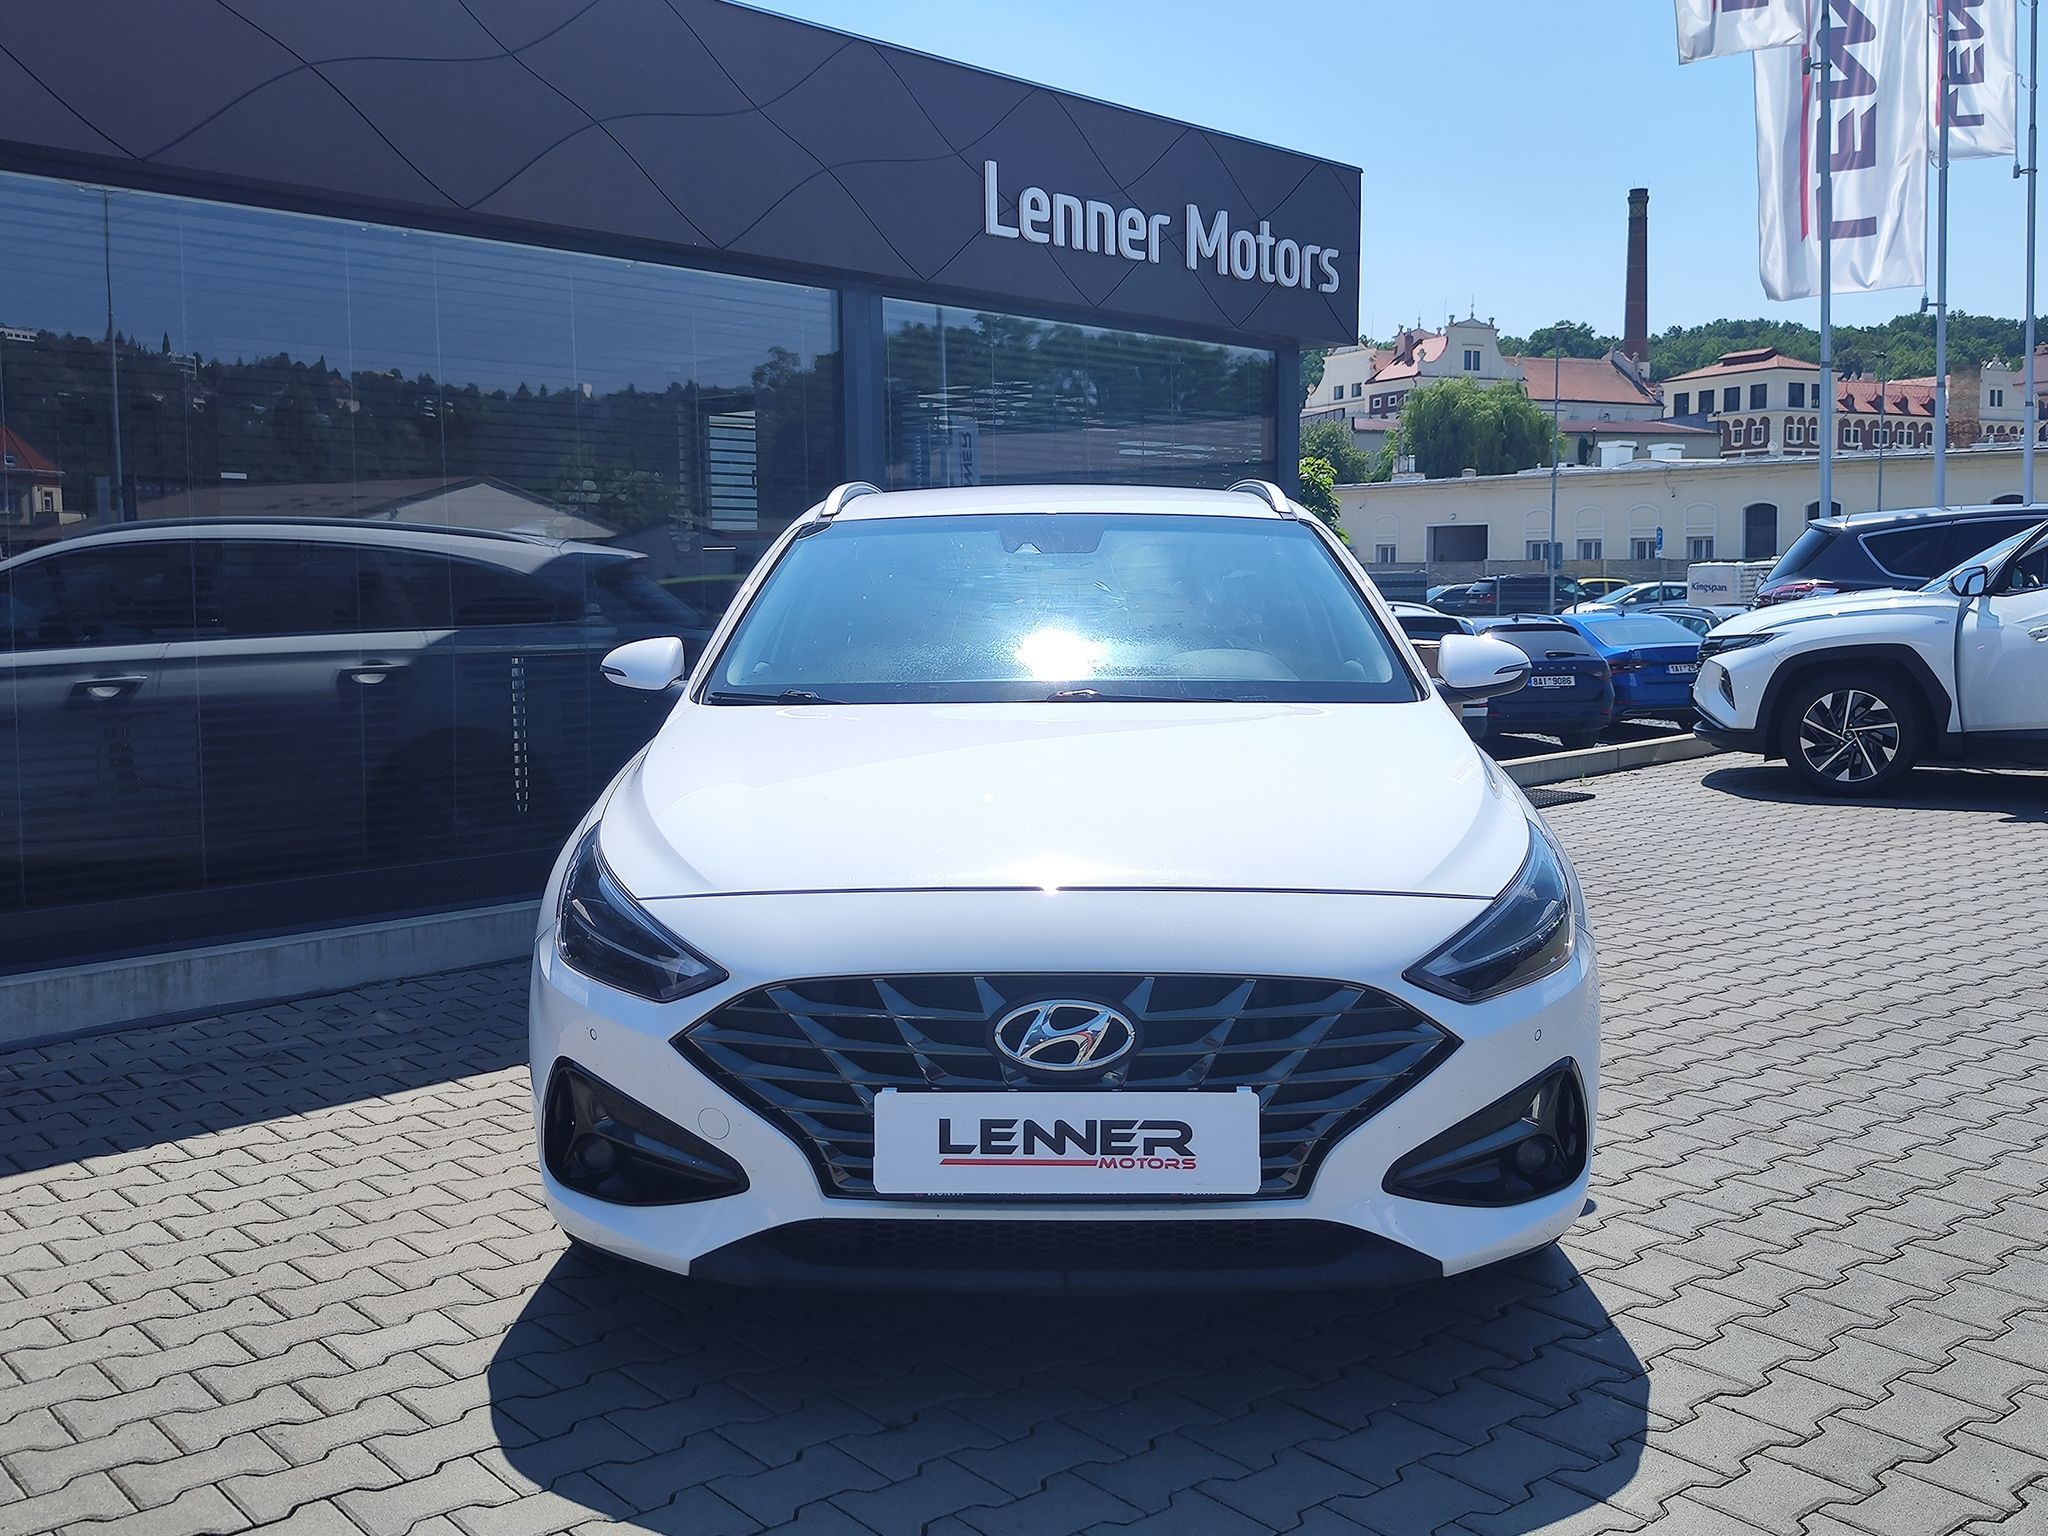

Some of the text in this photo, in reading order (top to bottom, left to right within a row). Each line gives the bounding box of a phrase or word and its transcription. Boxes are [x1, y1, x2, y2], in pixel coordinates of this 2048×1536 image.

[984, 160, 1340, 293] Lenner Motors
[1691, 581, 1727, 593] Kingspan
[938, 1118, 1196, 1156] LENNER
[1098, 1157, 1197, 1169] MOTORS
